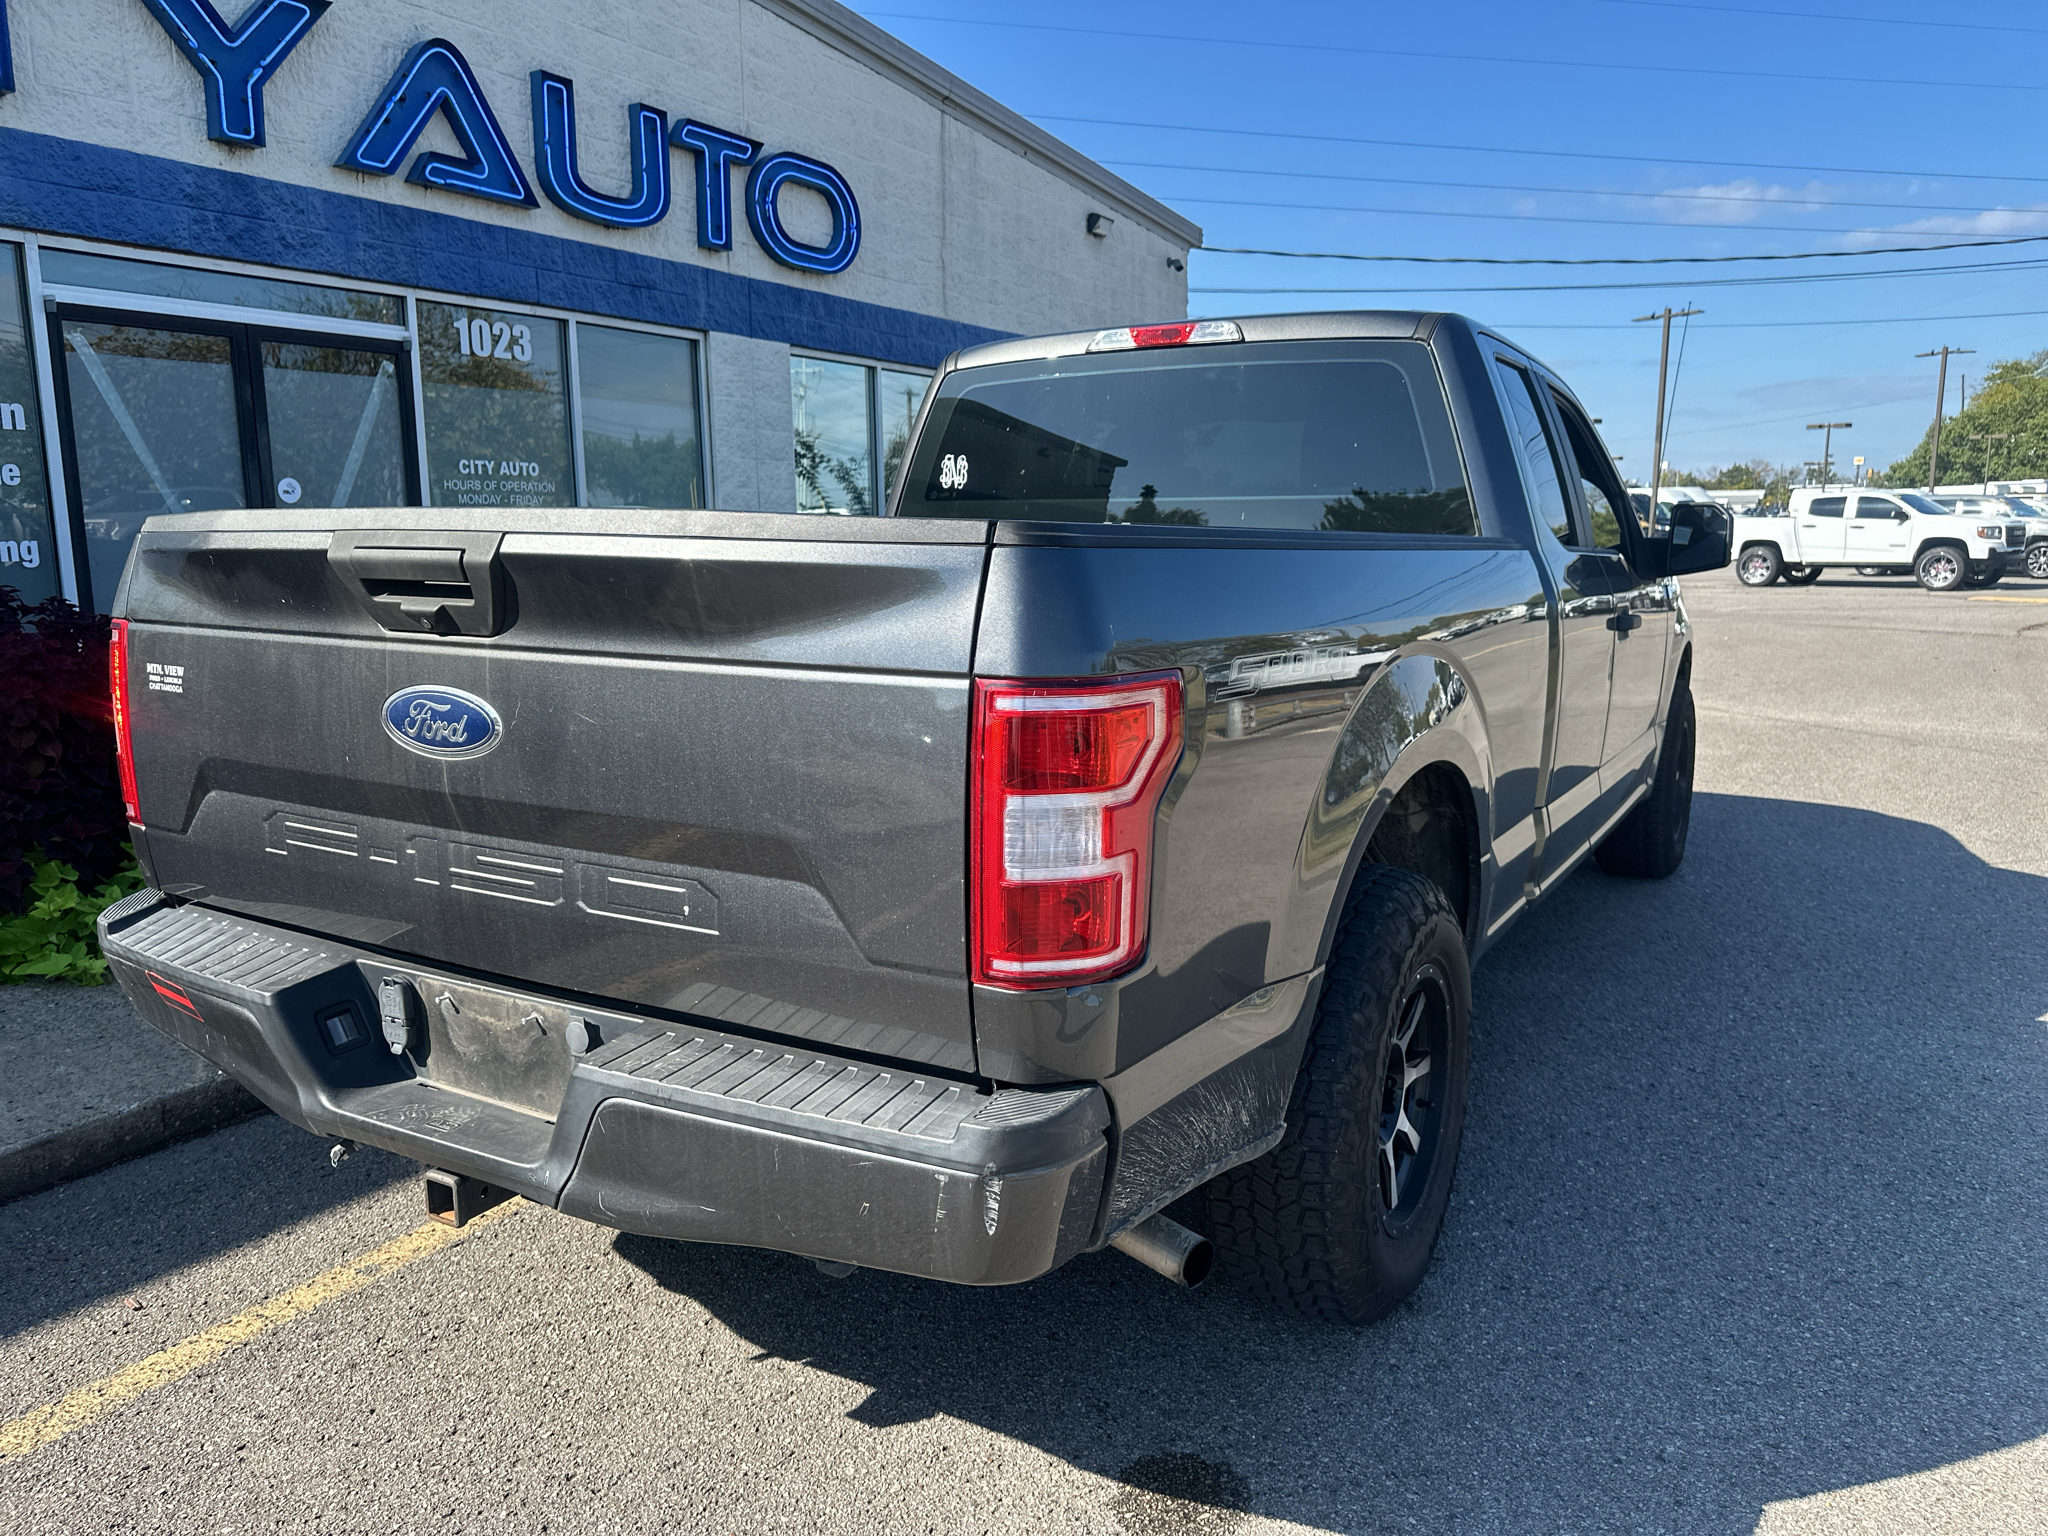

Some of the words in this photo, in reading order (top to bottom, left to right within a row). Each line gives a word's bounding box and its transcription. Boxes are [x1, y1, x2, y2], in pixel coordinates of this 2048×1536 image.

[0, 0, 333, 148] Y
[334, 38, 862, 274] AUTO
[453, 317, 533, 362] 1023
[0, 463, 21, 485] e
[458, 459, 494, 475] CITY
[500, 461, 540, 477] AUTO
[443, 479, 481, 491] HOURS
[483, 480, 498, 491] OF
[499, 481, 556, 492] OPERATION
[458, 493, 502, 505] MONDAY
[510, 495, 545, 506] FRIDAY
[164, 665, 184, 676] VIEW
[404, 699, 468, 743] Ford
[264, 809, 720, 936] F-150
